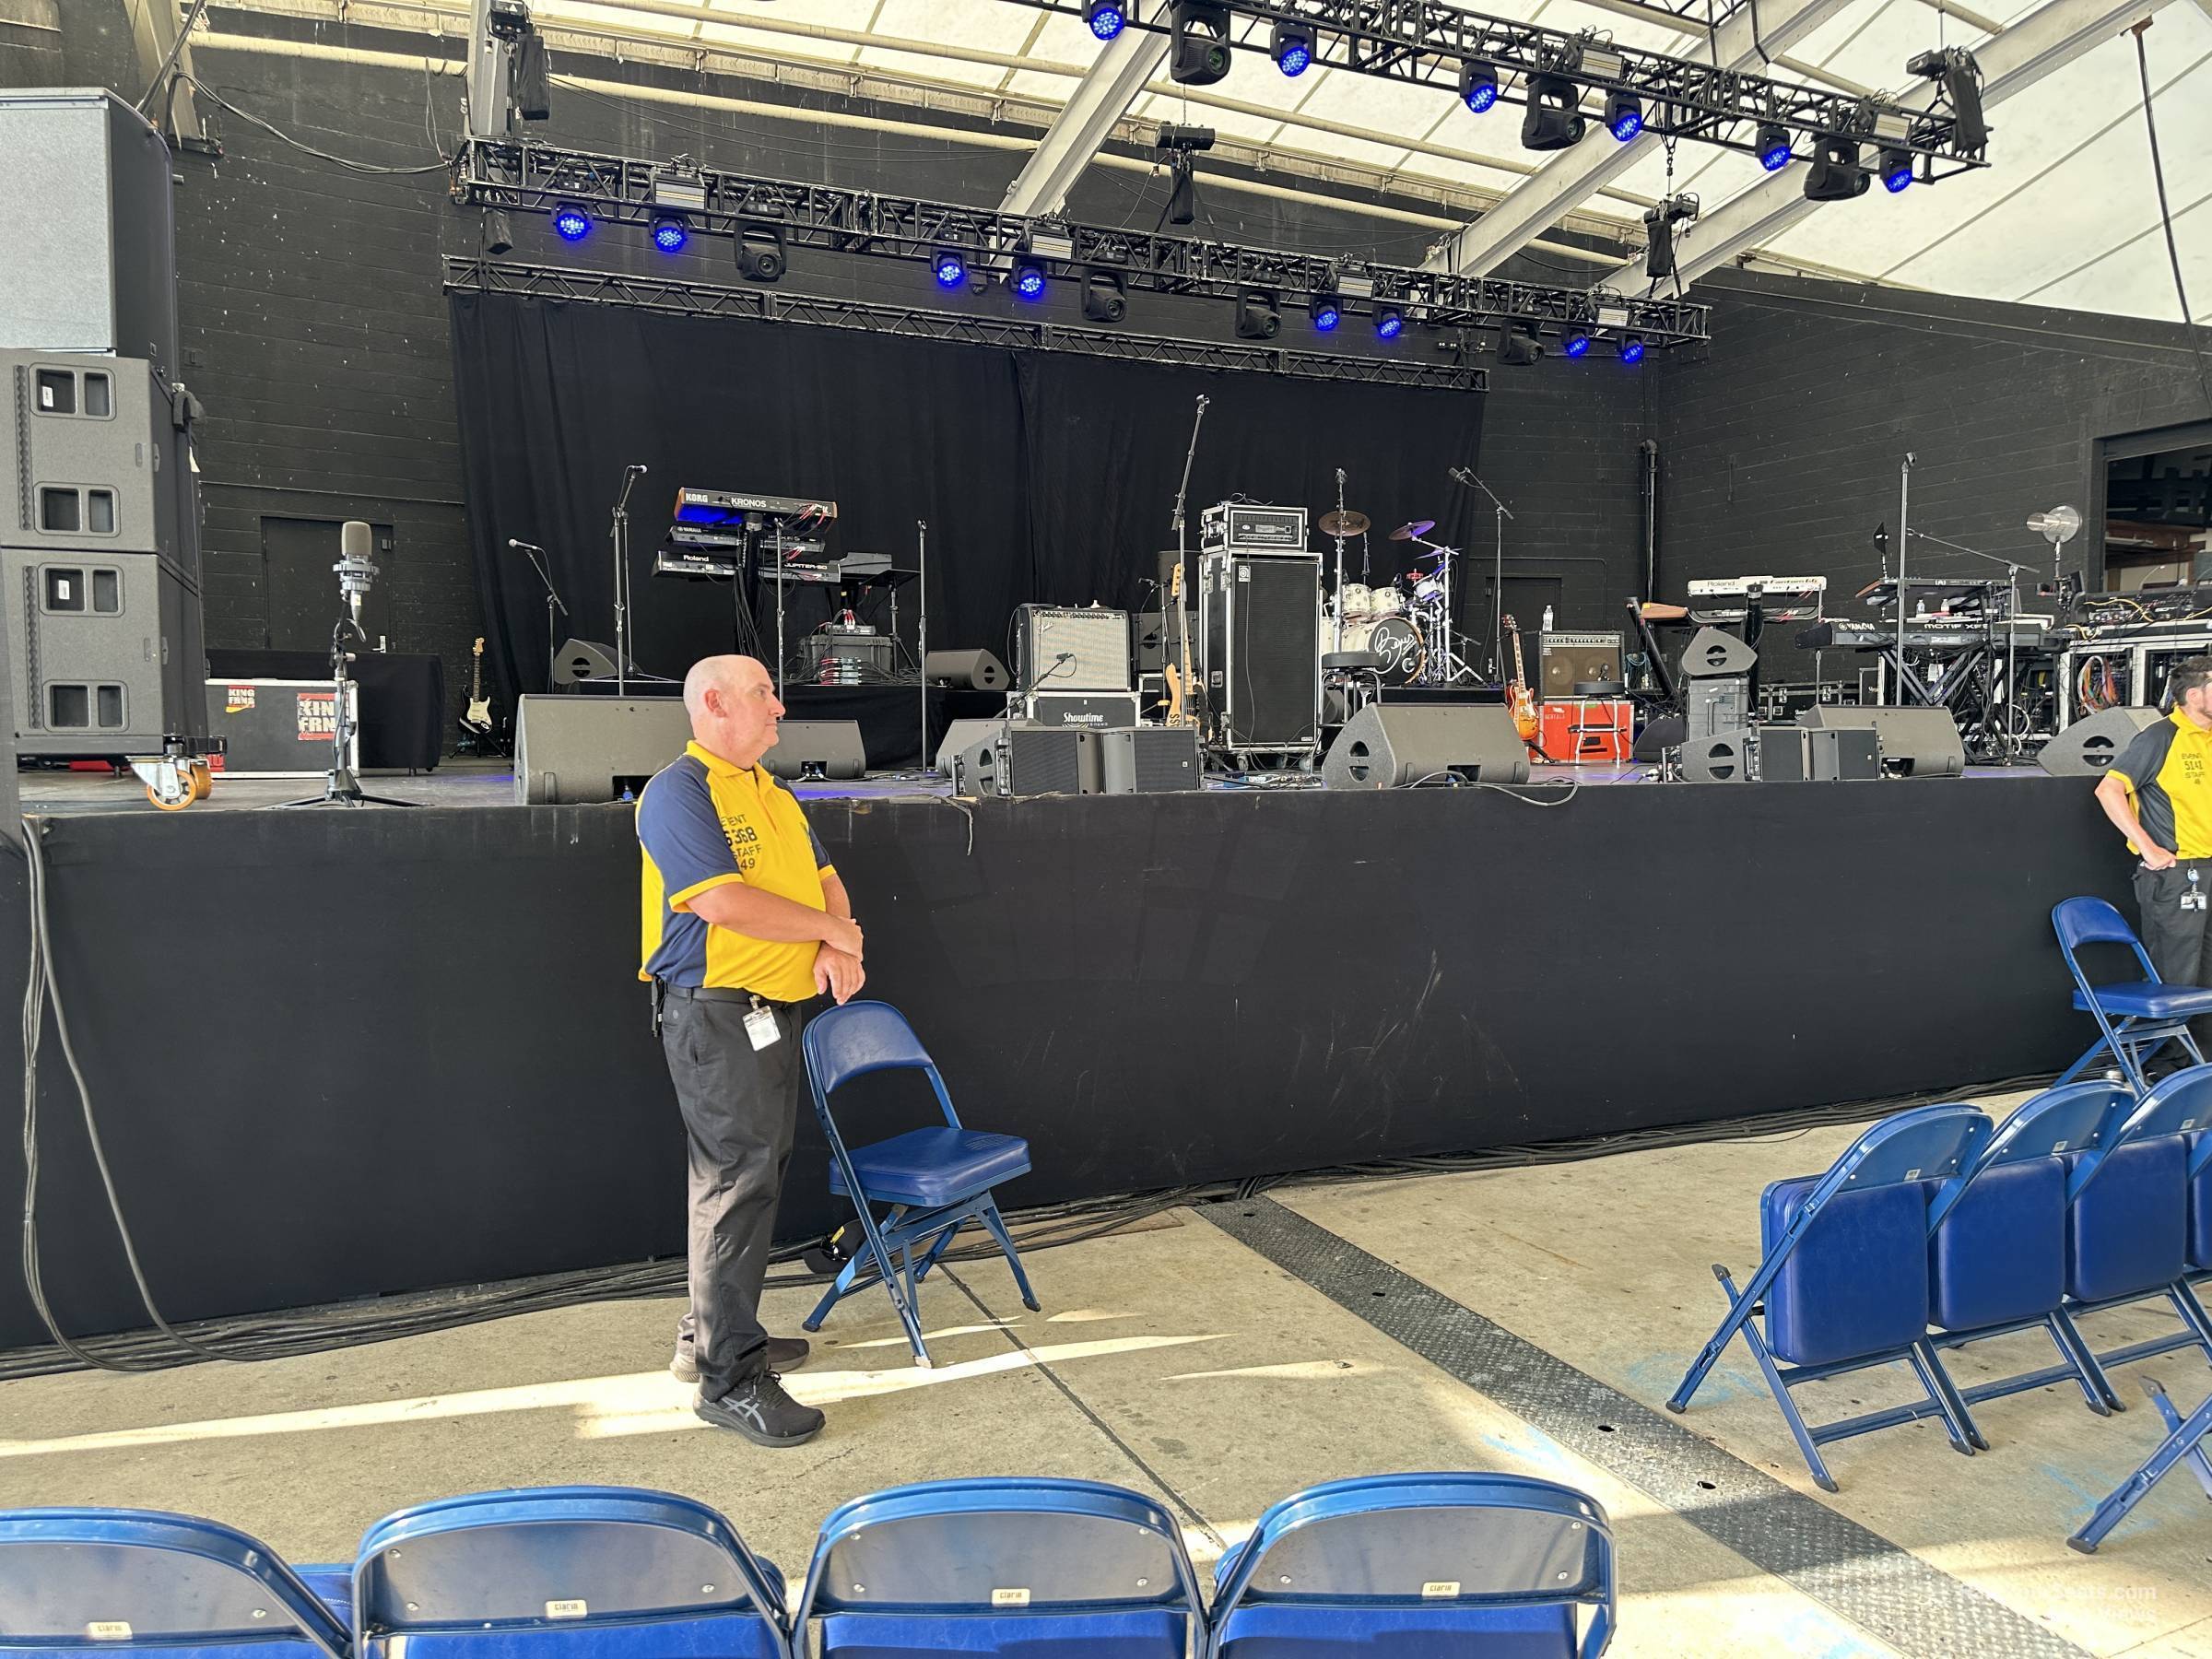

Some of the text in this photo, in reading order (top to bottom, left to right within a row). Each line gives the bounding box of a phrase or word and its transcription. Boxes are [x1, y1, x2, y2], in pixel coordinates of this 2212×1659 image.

[685, 492, 767, 508] KORG KRONOS
[683, 554, 710, 562] Roland
[299, 700, 350, 717] KIN
[1063, 712, 1104, 723] Showtime
[720, 813, 747, 828] EENT
